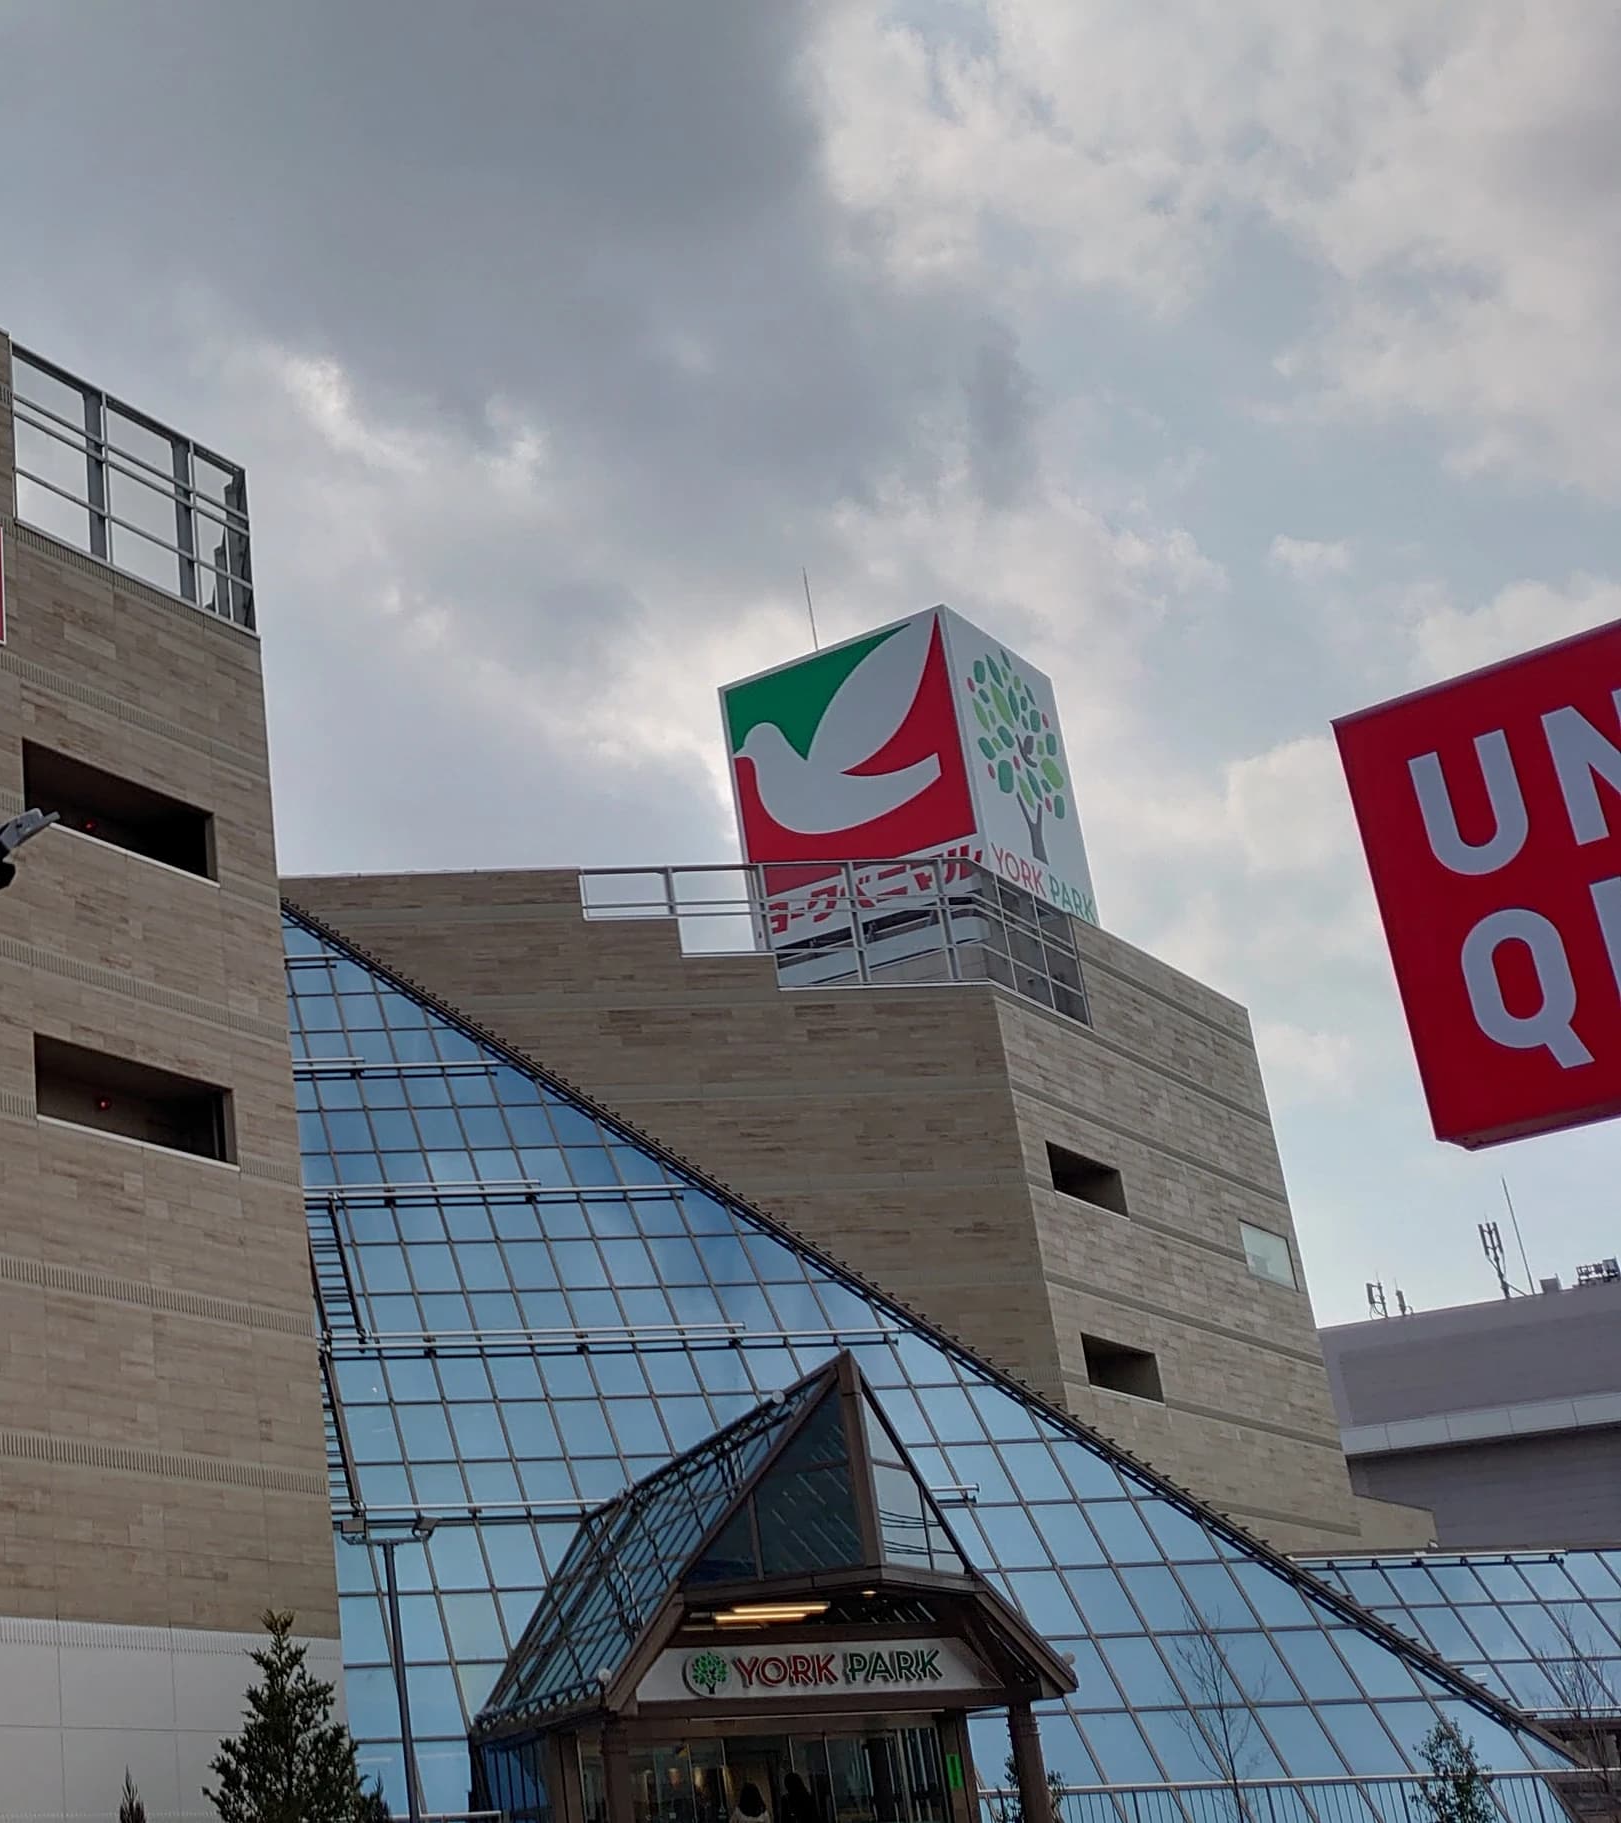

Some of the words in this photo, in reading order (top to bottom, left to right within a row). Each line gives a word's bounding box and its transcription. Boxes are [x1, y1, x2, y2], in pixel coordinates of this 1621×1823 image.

[990, 842, 1047, 898] YORK
[1048, 873, 1097, 925] PARK
[733, 1653, 840, 1688] YORK
[843, 1648, 944, 1684] PARK
